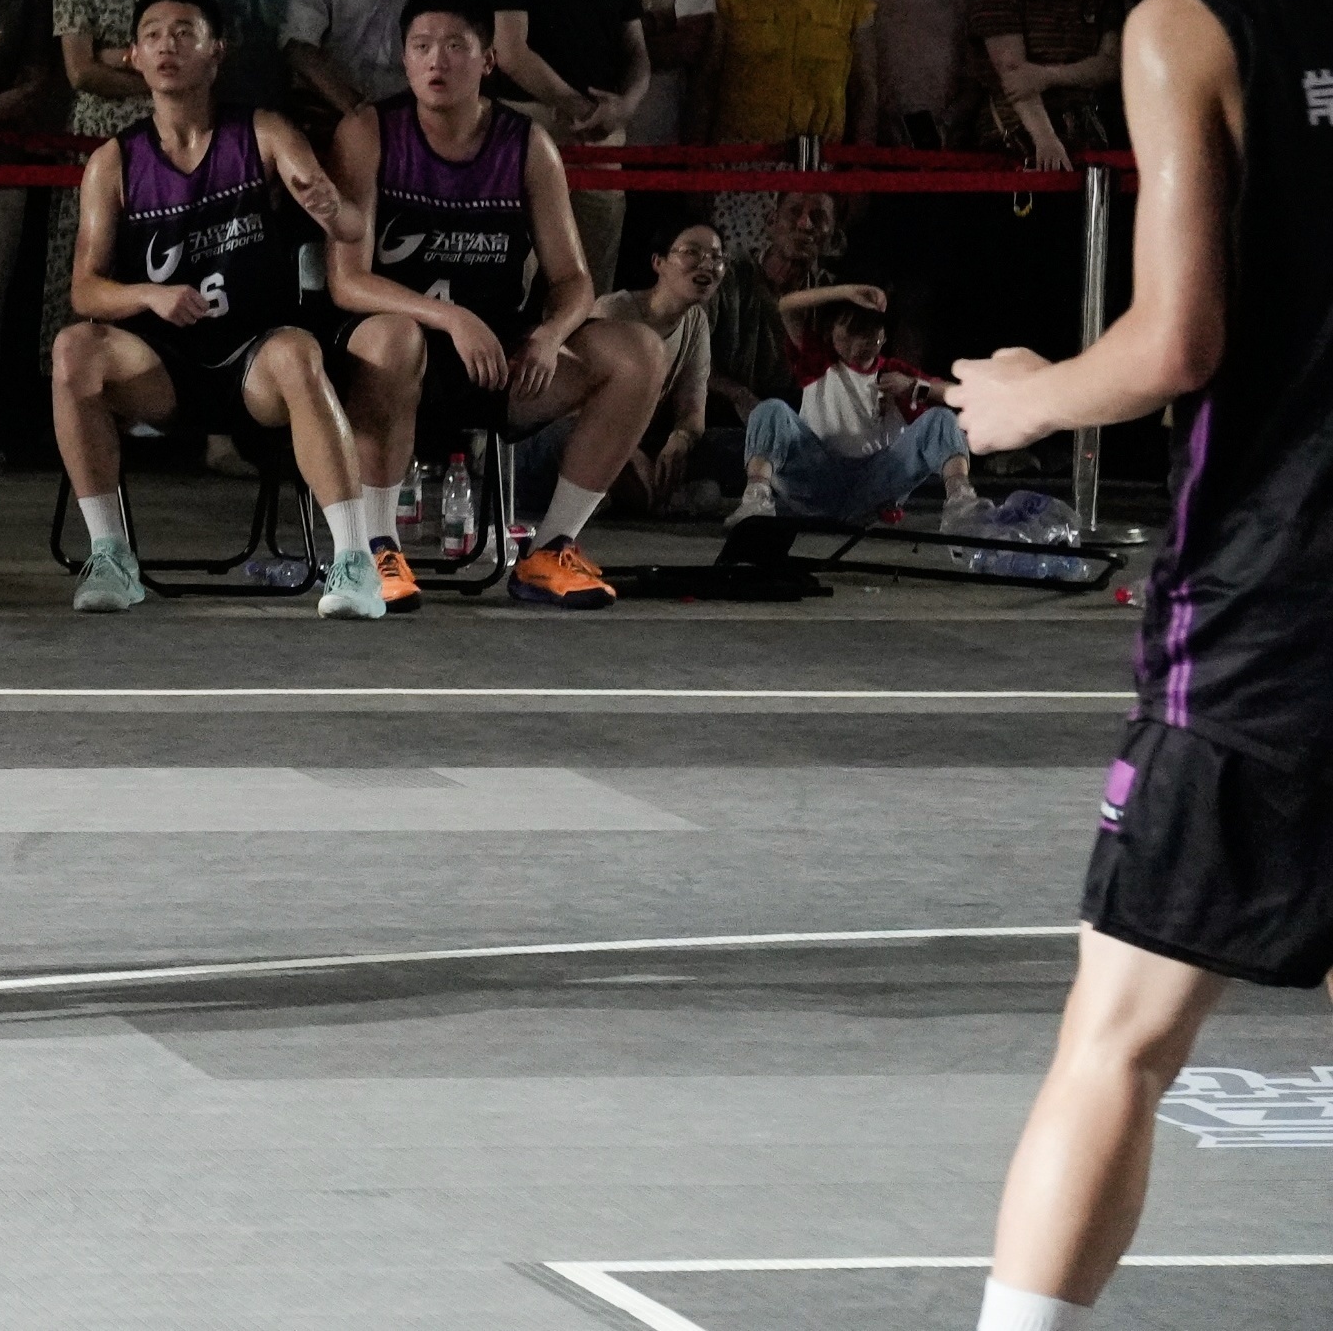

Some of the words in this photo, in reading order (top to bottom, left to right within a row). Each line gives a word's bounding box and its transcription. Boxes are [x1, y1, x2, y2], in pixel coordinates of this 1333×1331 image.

[225, 230, 265, 252] sports
[428, 229, 510, 252] 五星体育
[423, 251, 462, 263] great
[463, 252, 507, 266] sports
